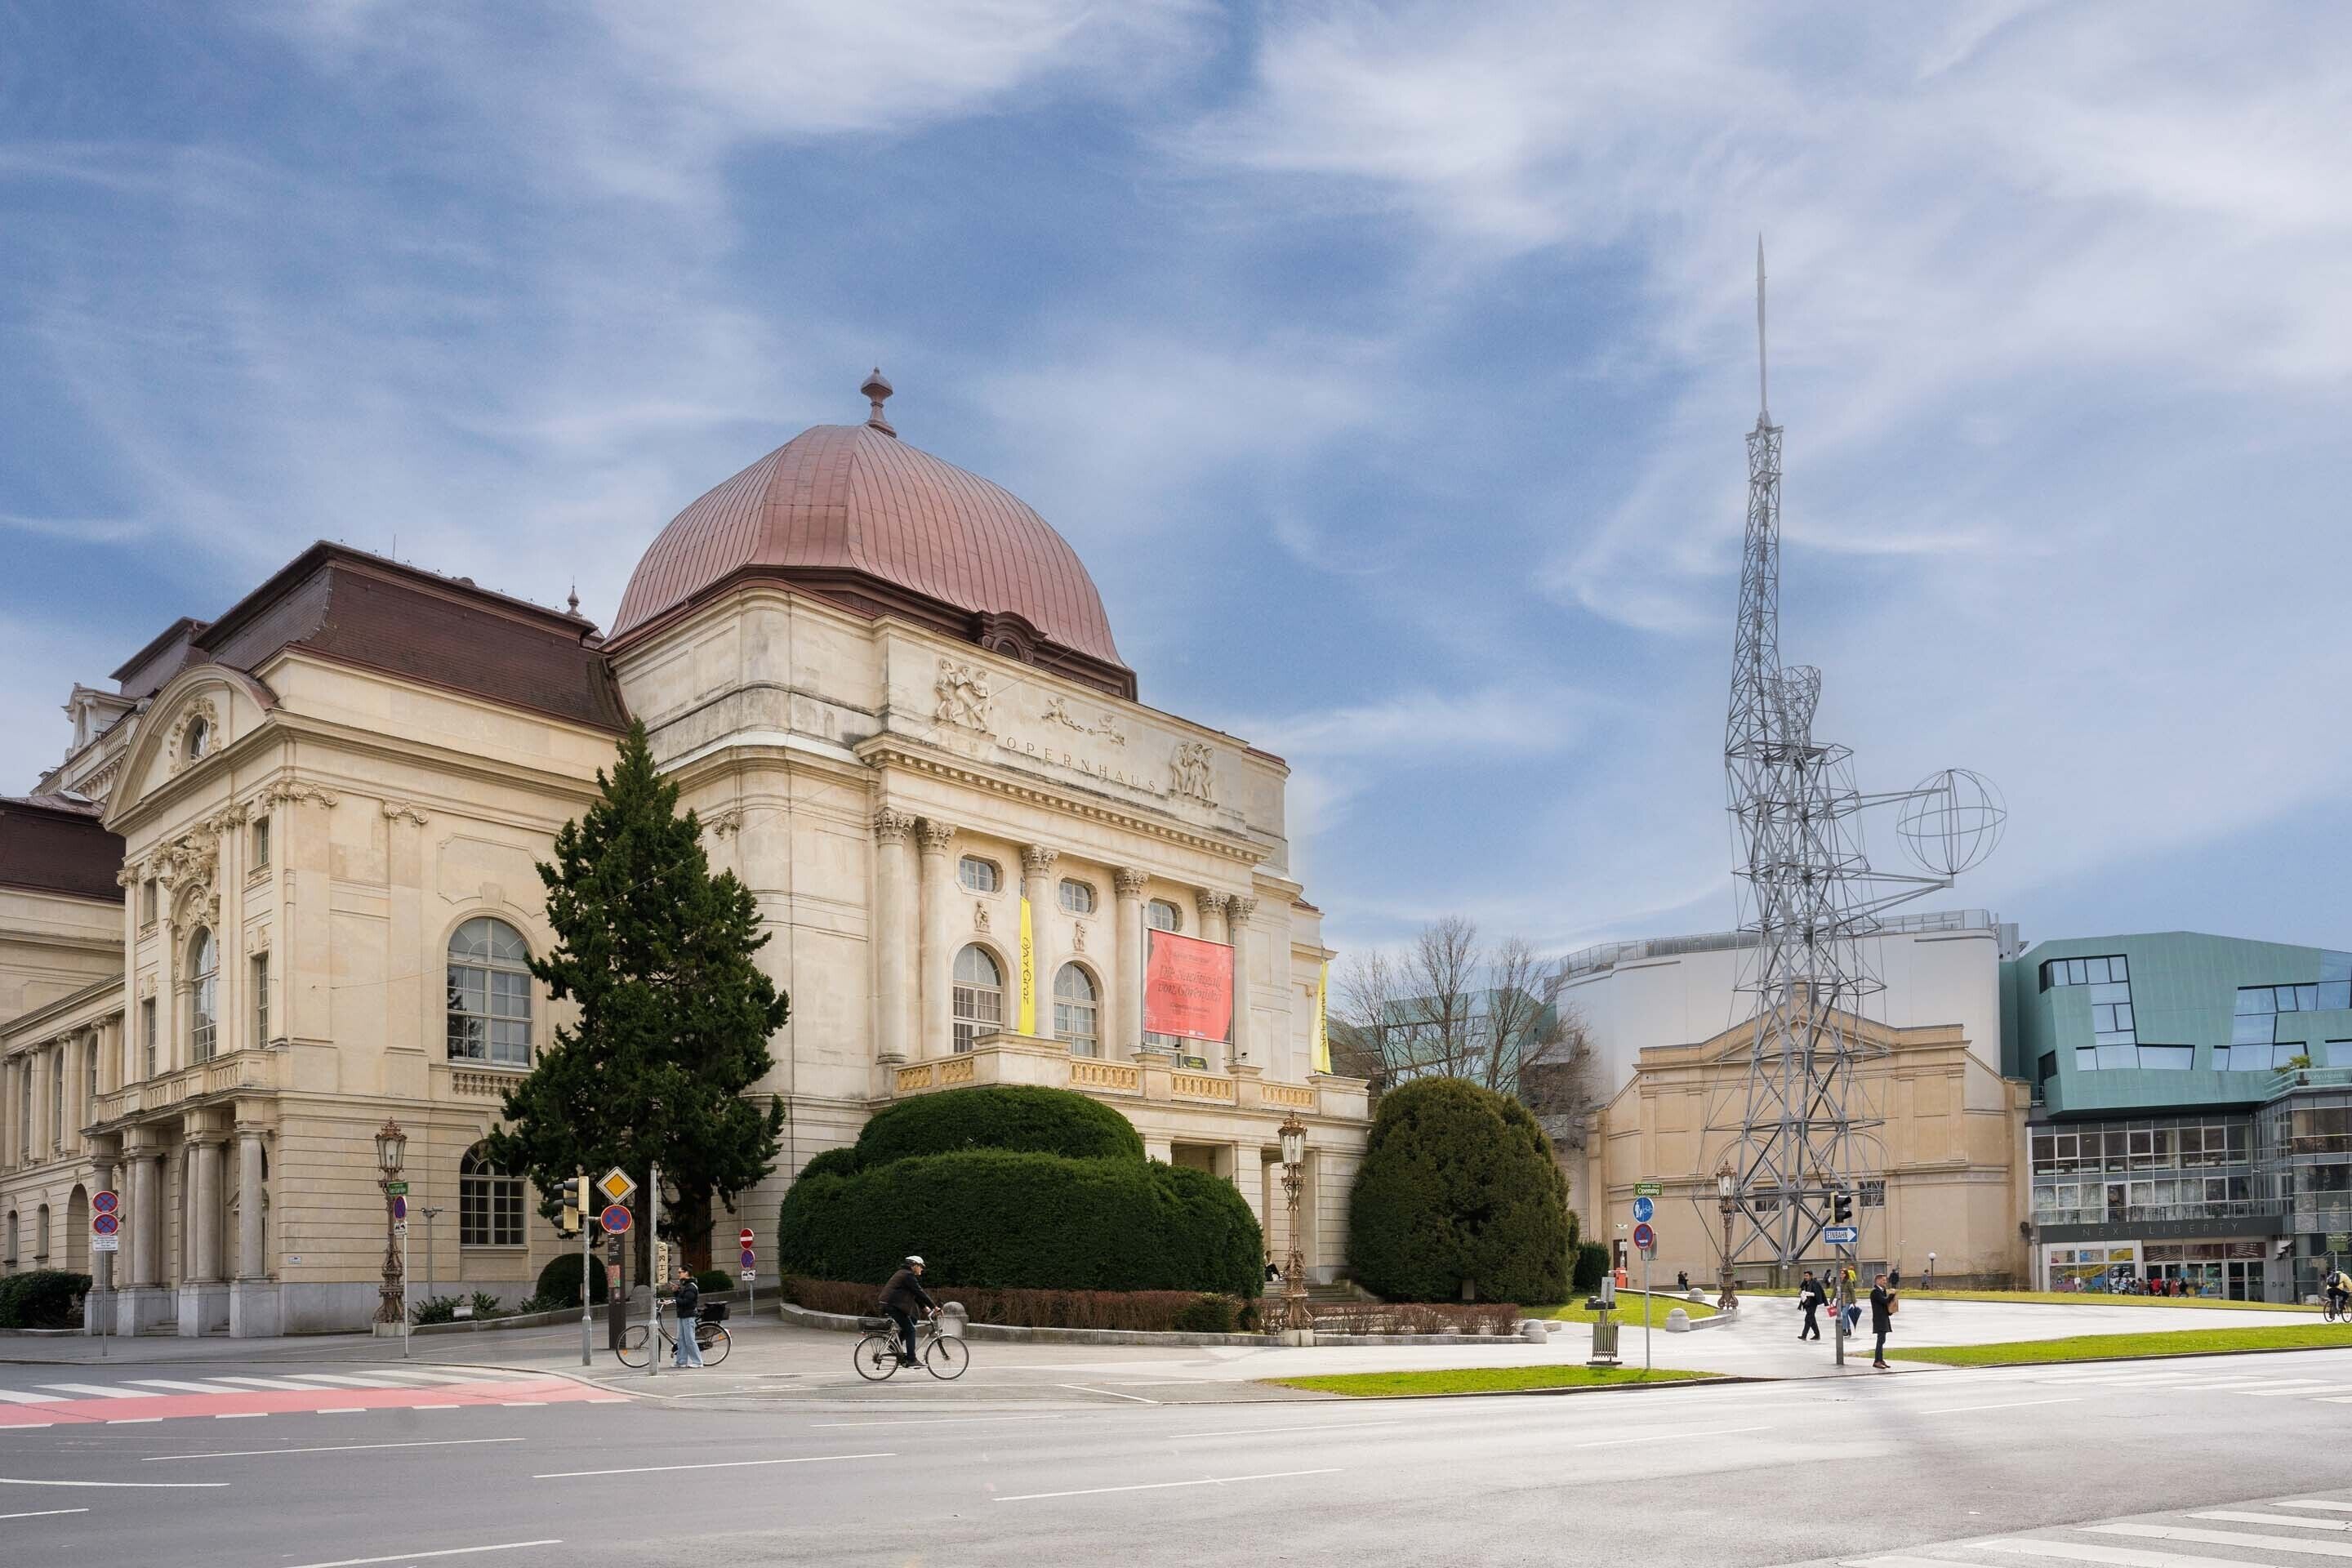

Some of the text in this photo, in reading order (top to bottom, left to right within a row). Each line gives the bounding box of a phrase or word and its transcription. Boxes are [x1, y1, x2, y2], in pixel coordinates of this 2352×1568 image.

[1006, 737, 1156, 792] OPERNHAUS
[1827, 1231, 1848, 1239] EINBAHN
[2082, 1222, 2240, 1236] NEXT LIBERTY
